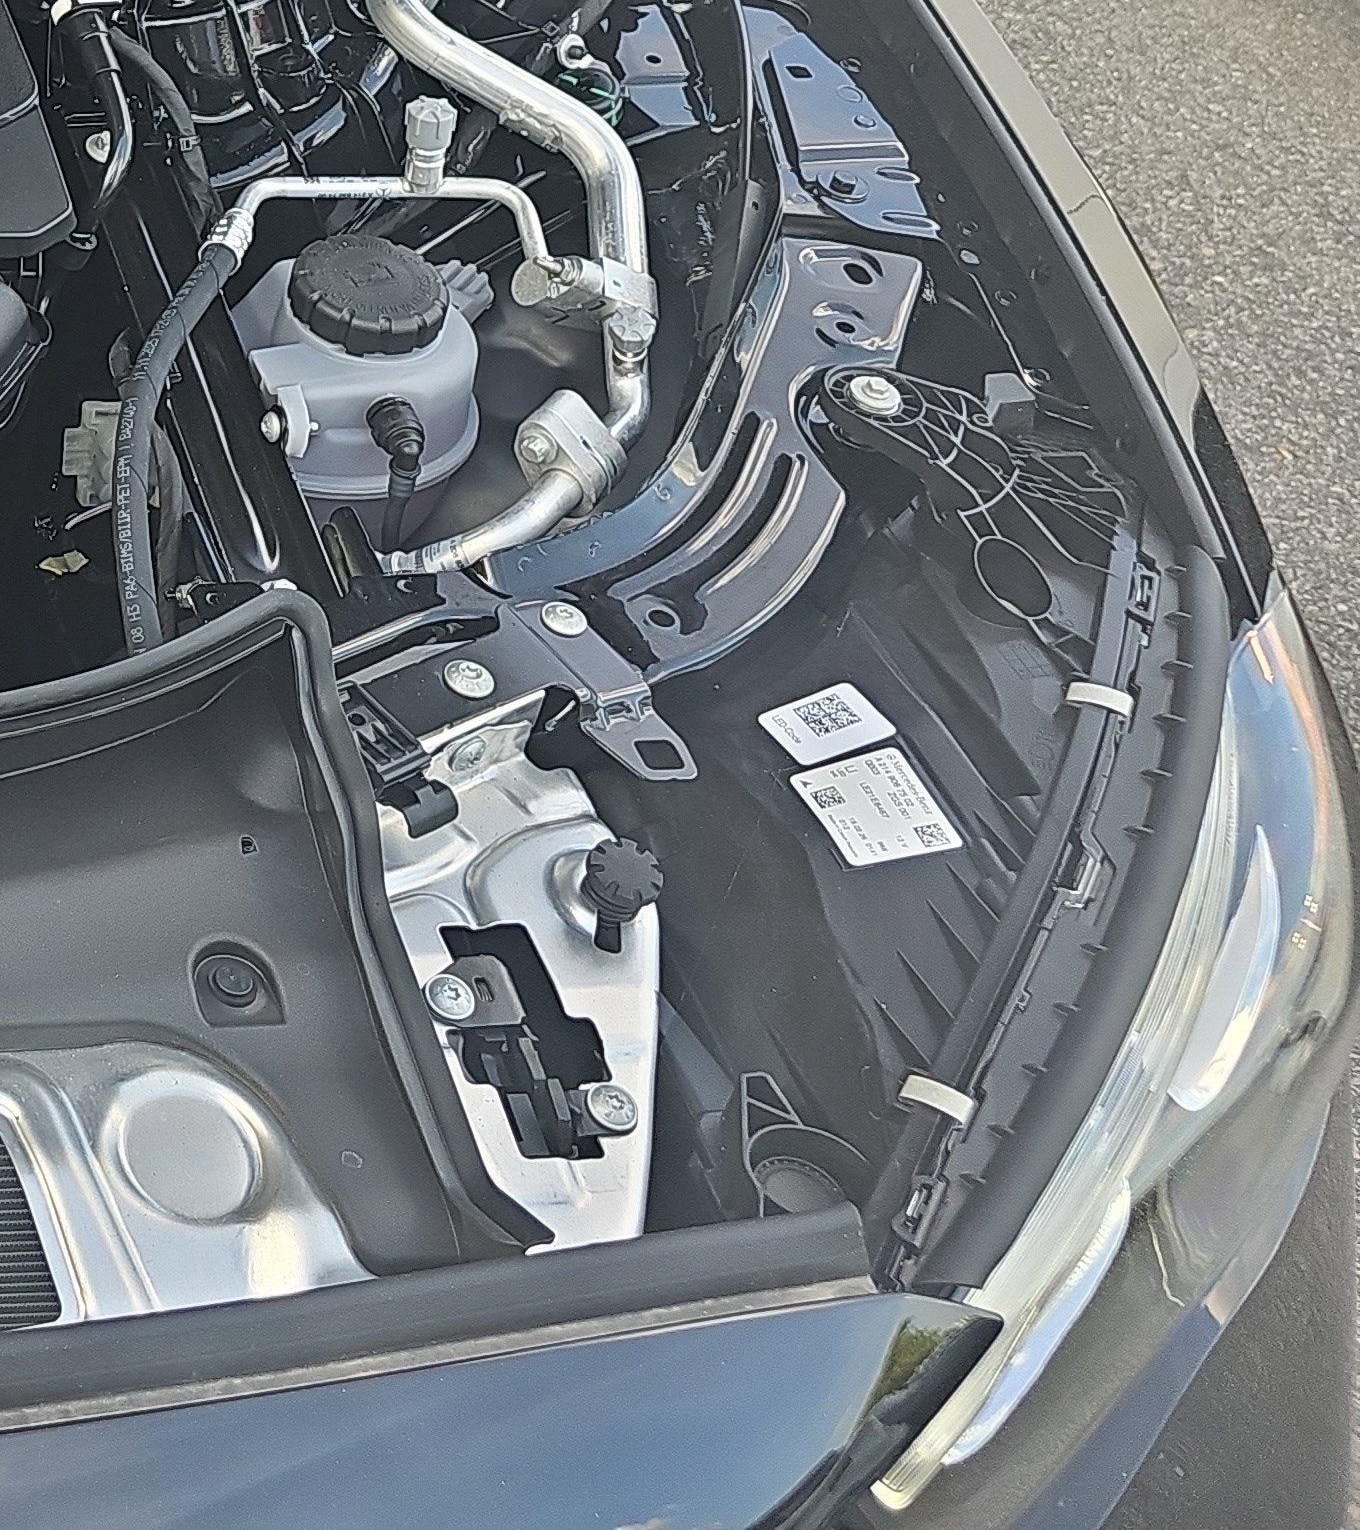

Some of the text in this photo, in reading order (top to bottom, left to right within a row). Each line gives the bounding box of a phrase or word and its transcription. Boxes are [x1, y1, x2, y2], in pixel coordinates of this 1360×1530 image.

[770, 713, 804, 744] LED-Code
[878, 761, 892, 774] 214
[889, 760, 935, 815] Mercedes-Benz
